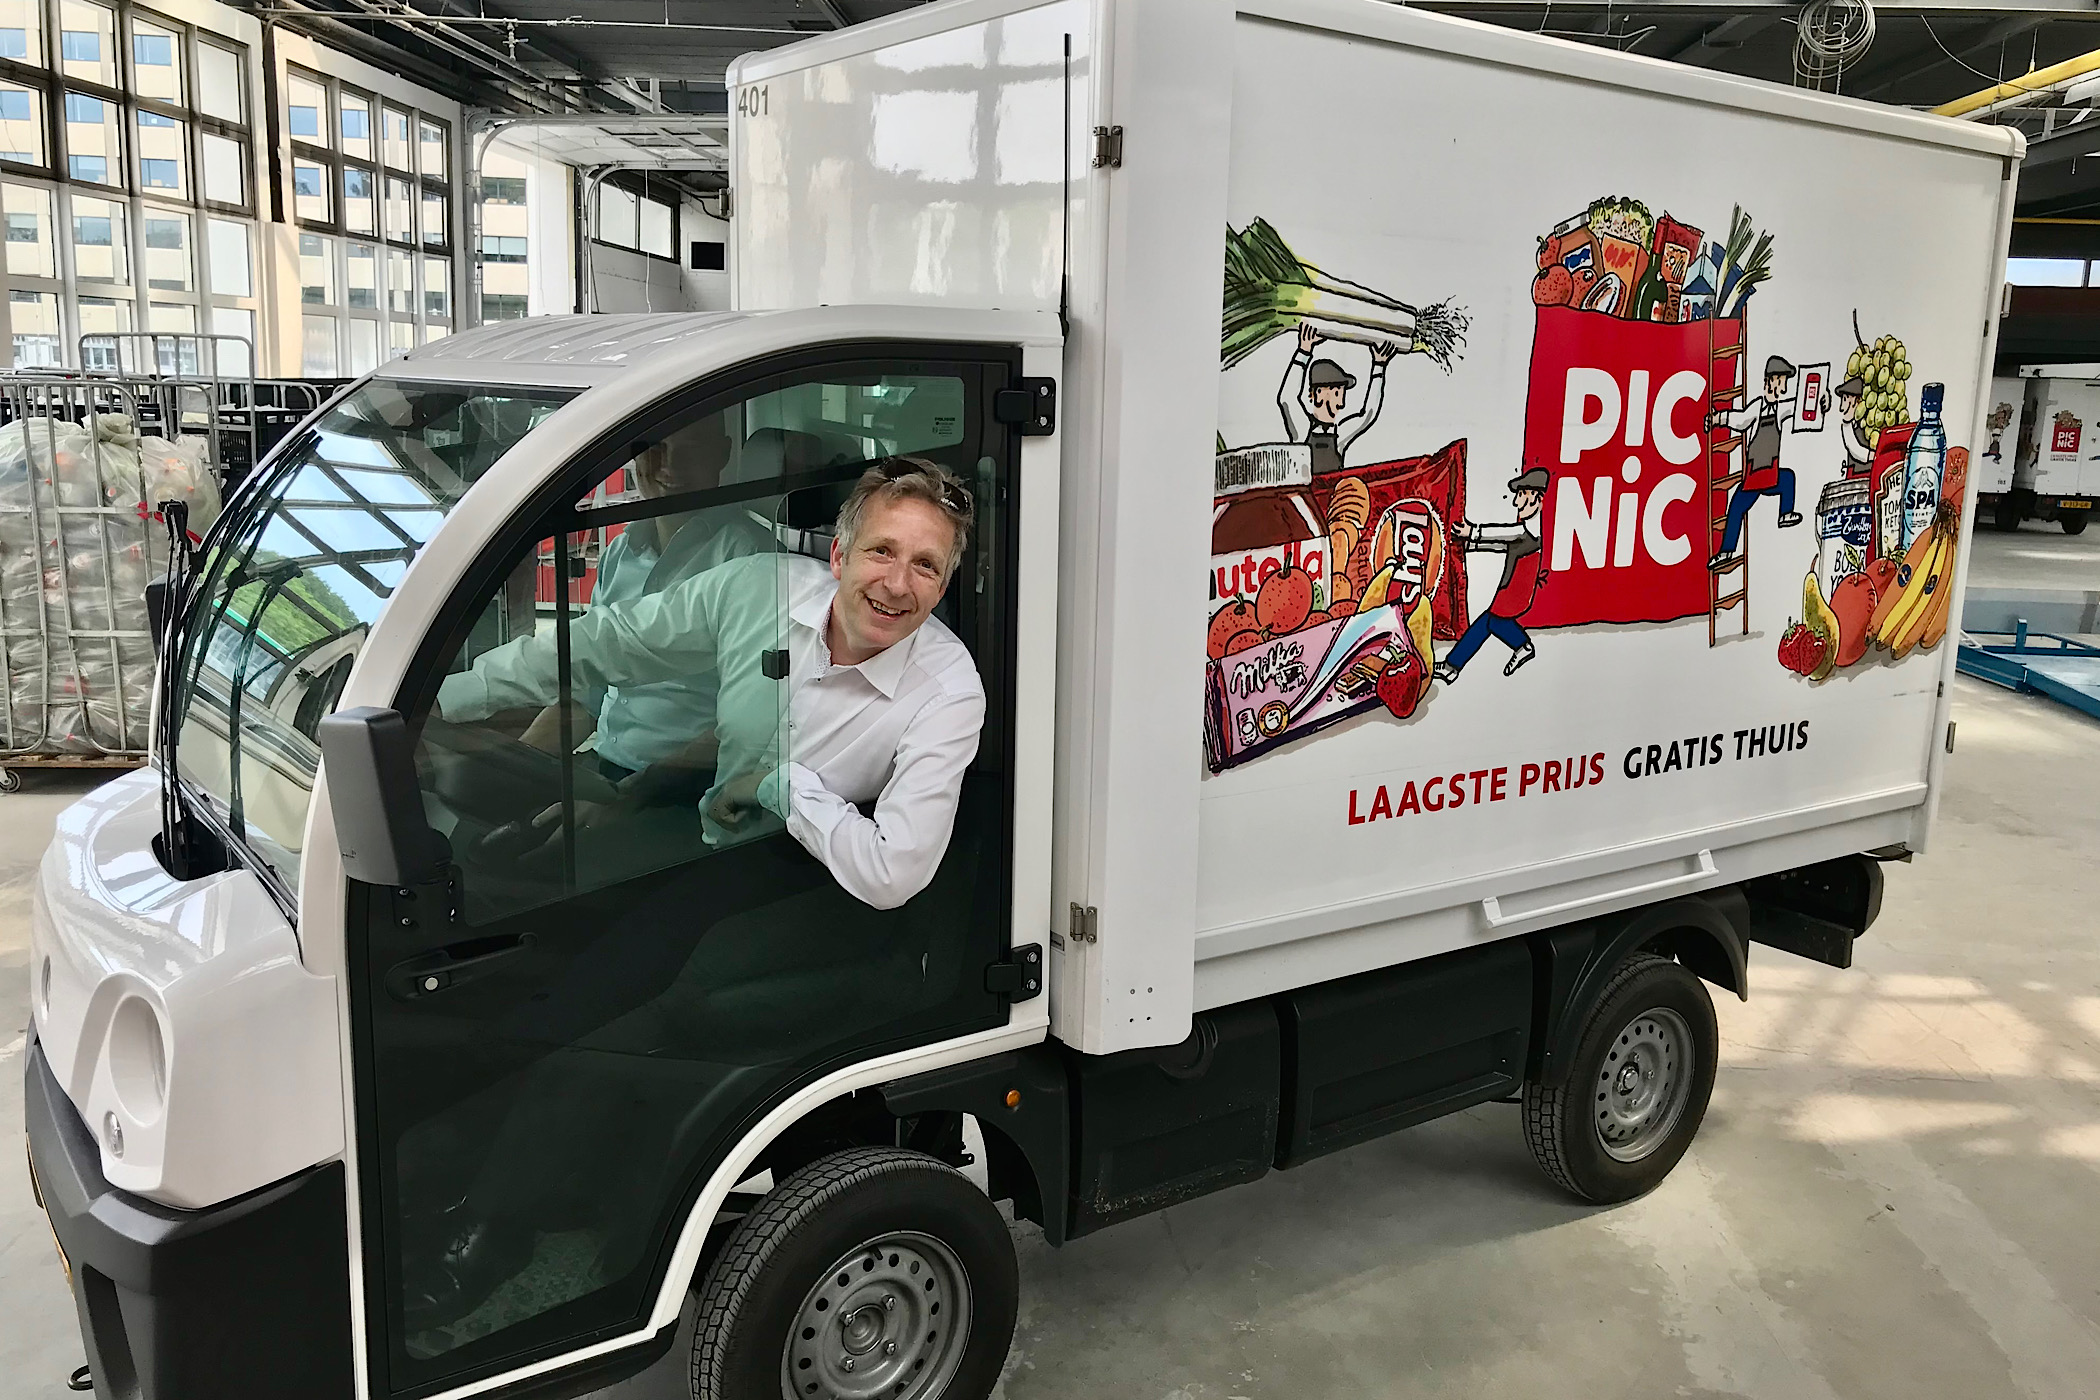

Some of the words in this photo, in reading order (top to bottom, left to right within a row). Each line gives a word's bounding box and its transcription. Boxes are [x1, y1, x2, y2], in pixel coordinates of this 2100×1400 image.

[738, 84, 769, 118] 401
[1560, 367, 1707, 465] PIC
[2057, 431, 2076, 440] PIC
[1905, 488, 1937, 510] SPA
[1229, 641, 1304, 700] Milka
[1347, 766, 1508, 826] LAAGSTE
[1518, 752, 1606, 797] PRIJS
[1623, 733, 1724, 779] GRATIS
[1733, 719, 1810, 761] THUIS
